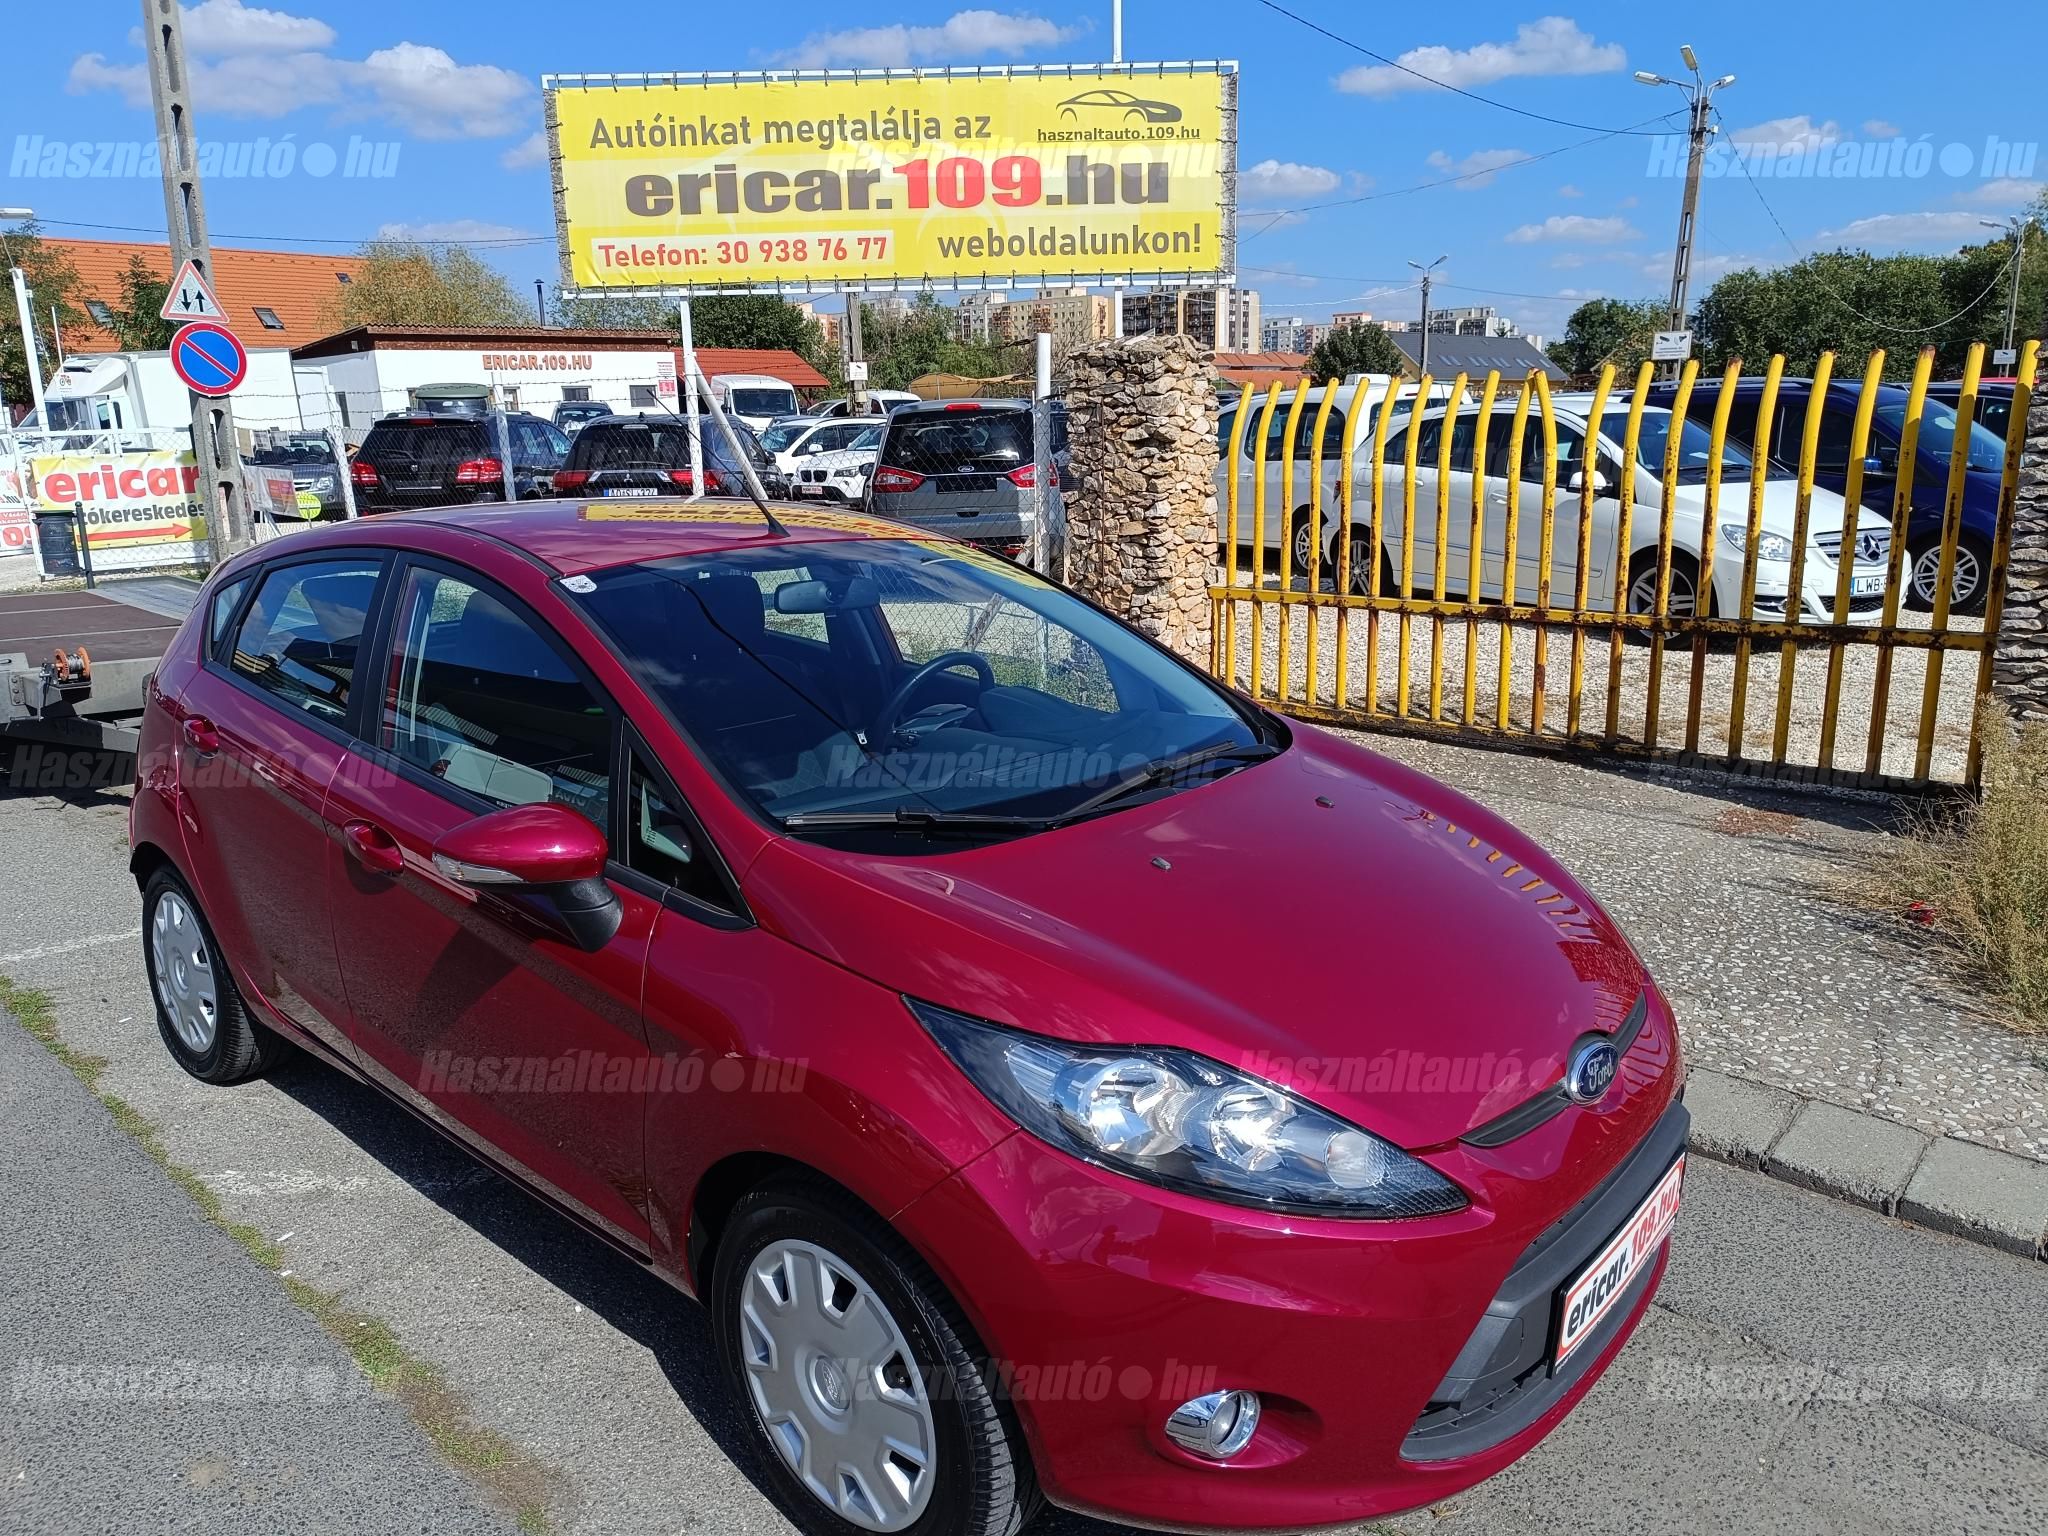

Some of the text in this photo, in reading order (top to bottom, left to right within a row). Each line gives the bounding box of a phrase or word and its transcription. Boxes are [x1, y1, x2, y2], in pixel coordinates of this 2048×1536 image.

[589, 105, 992, 151] Autóinkat megtalálja az
[1037, 126, 1201, 142] hasznaltauto.109.hu
[624, 154, 1169, 217] ericar.109.hu
[598, 236, 888, 268] Telefon: 30 938 76 77
[937, 222, 1201, 258] weboldalunkon!
[482, 354, 593, 370] ERICAR.109.HU
[45, 464, 200, 503] ericar
[1586, 1052, 1613, 1092] Ford
